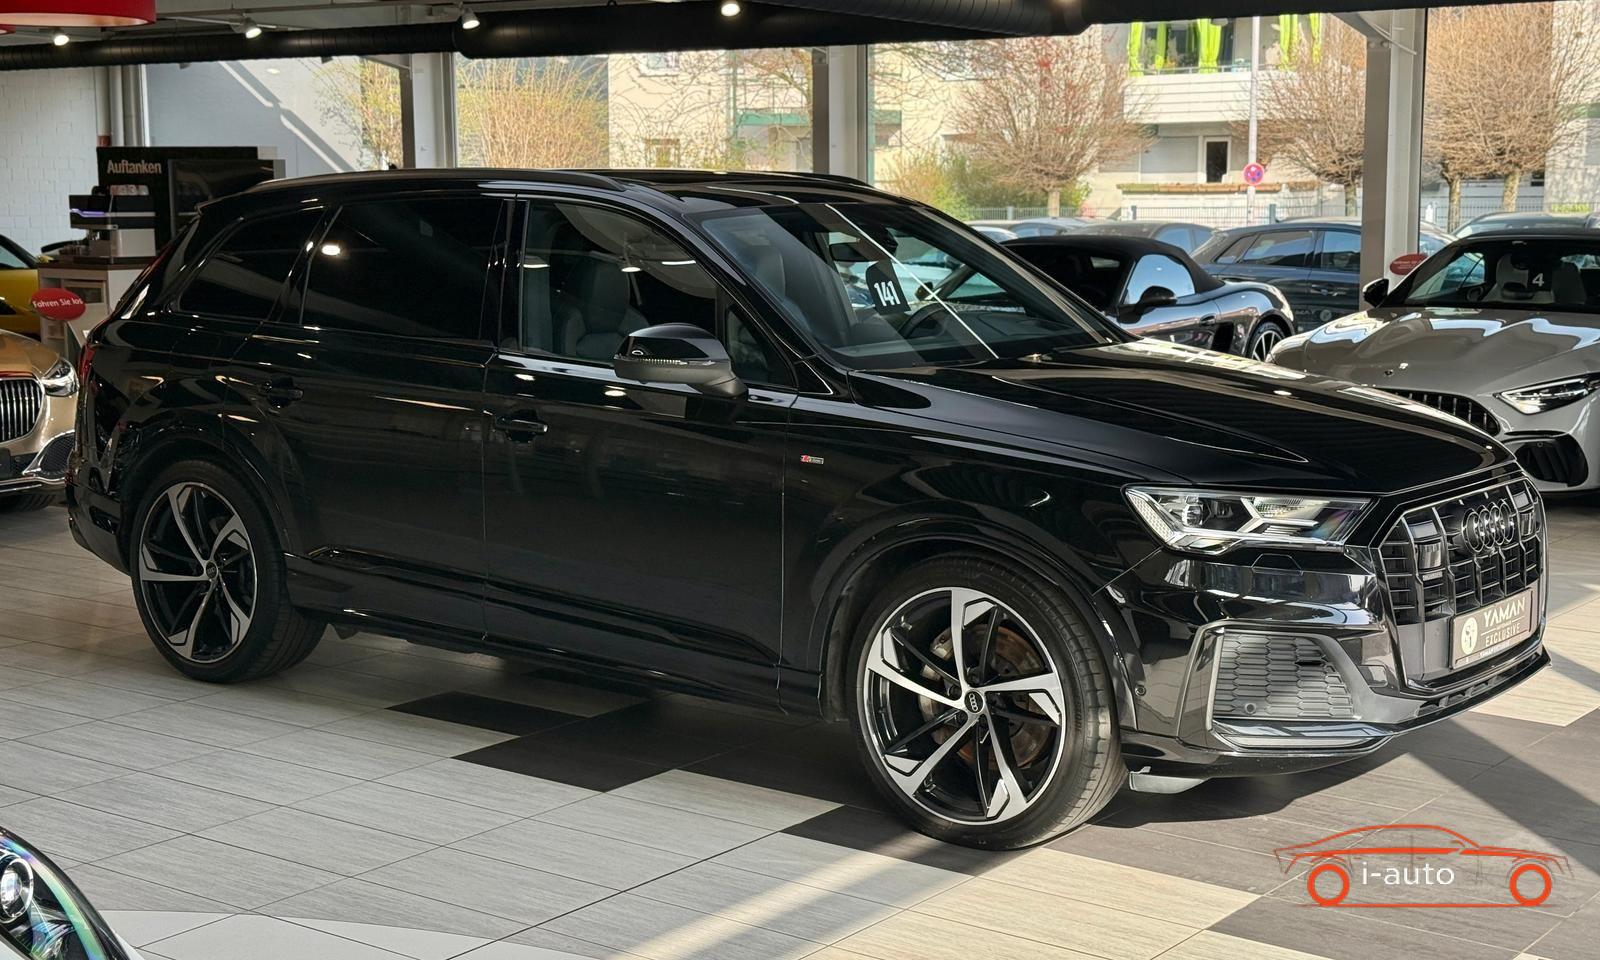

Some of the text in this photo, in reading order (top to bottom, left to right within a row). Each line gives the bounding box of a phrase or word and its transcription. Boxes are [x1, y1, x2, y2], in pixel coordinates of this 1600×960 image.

[107, 159, 162, 174] Auftanken
[1532, 272, 1545, 287] 4
[32, 299, 60, 308] Fahren
[60, 298, 72, 306] Sie
[873, 280, 901, 307] 141
[1483, 596, 1526, 628] YAMAN
[1485, 622, 1521, 648] EXCLUSIVE
